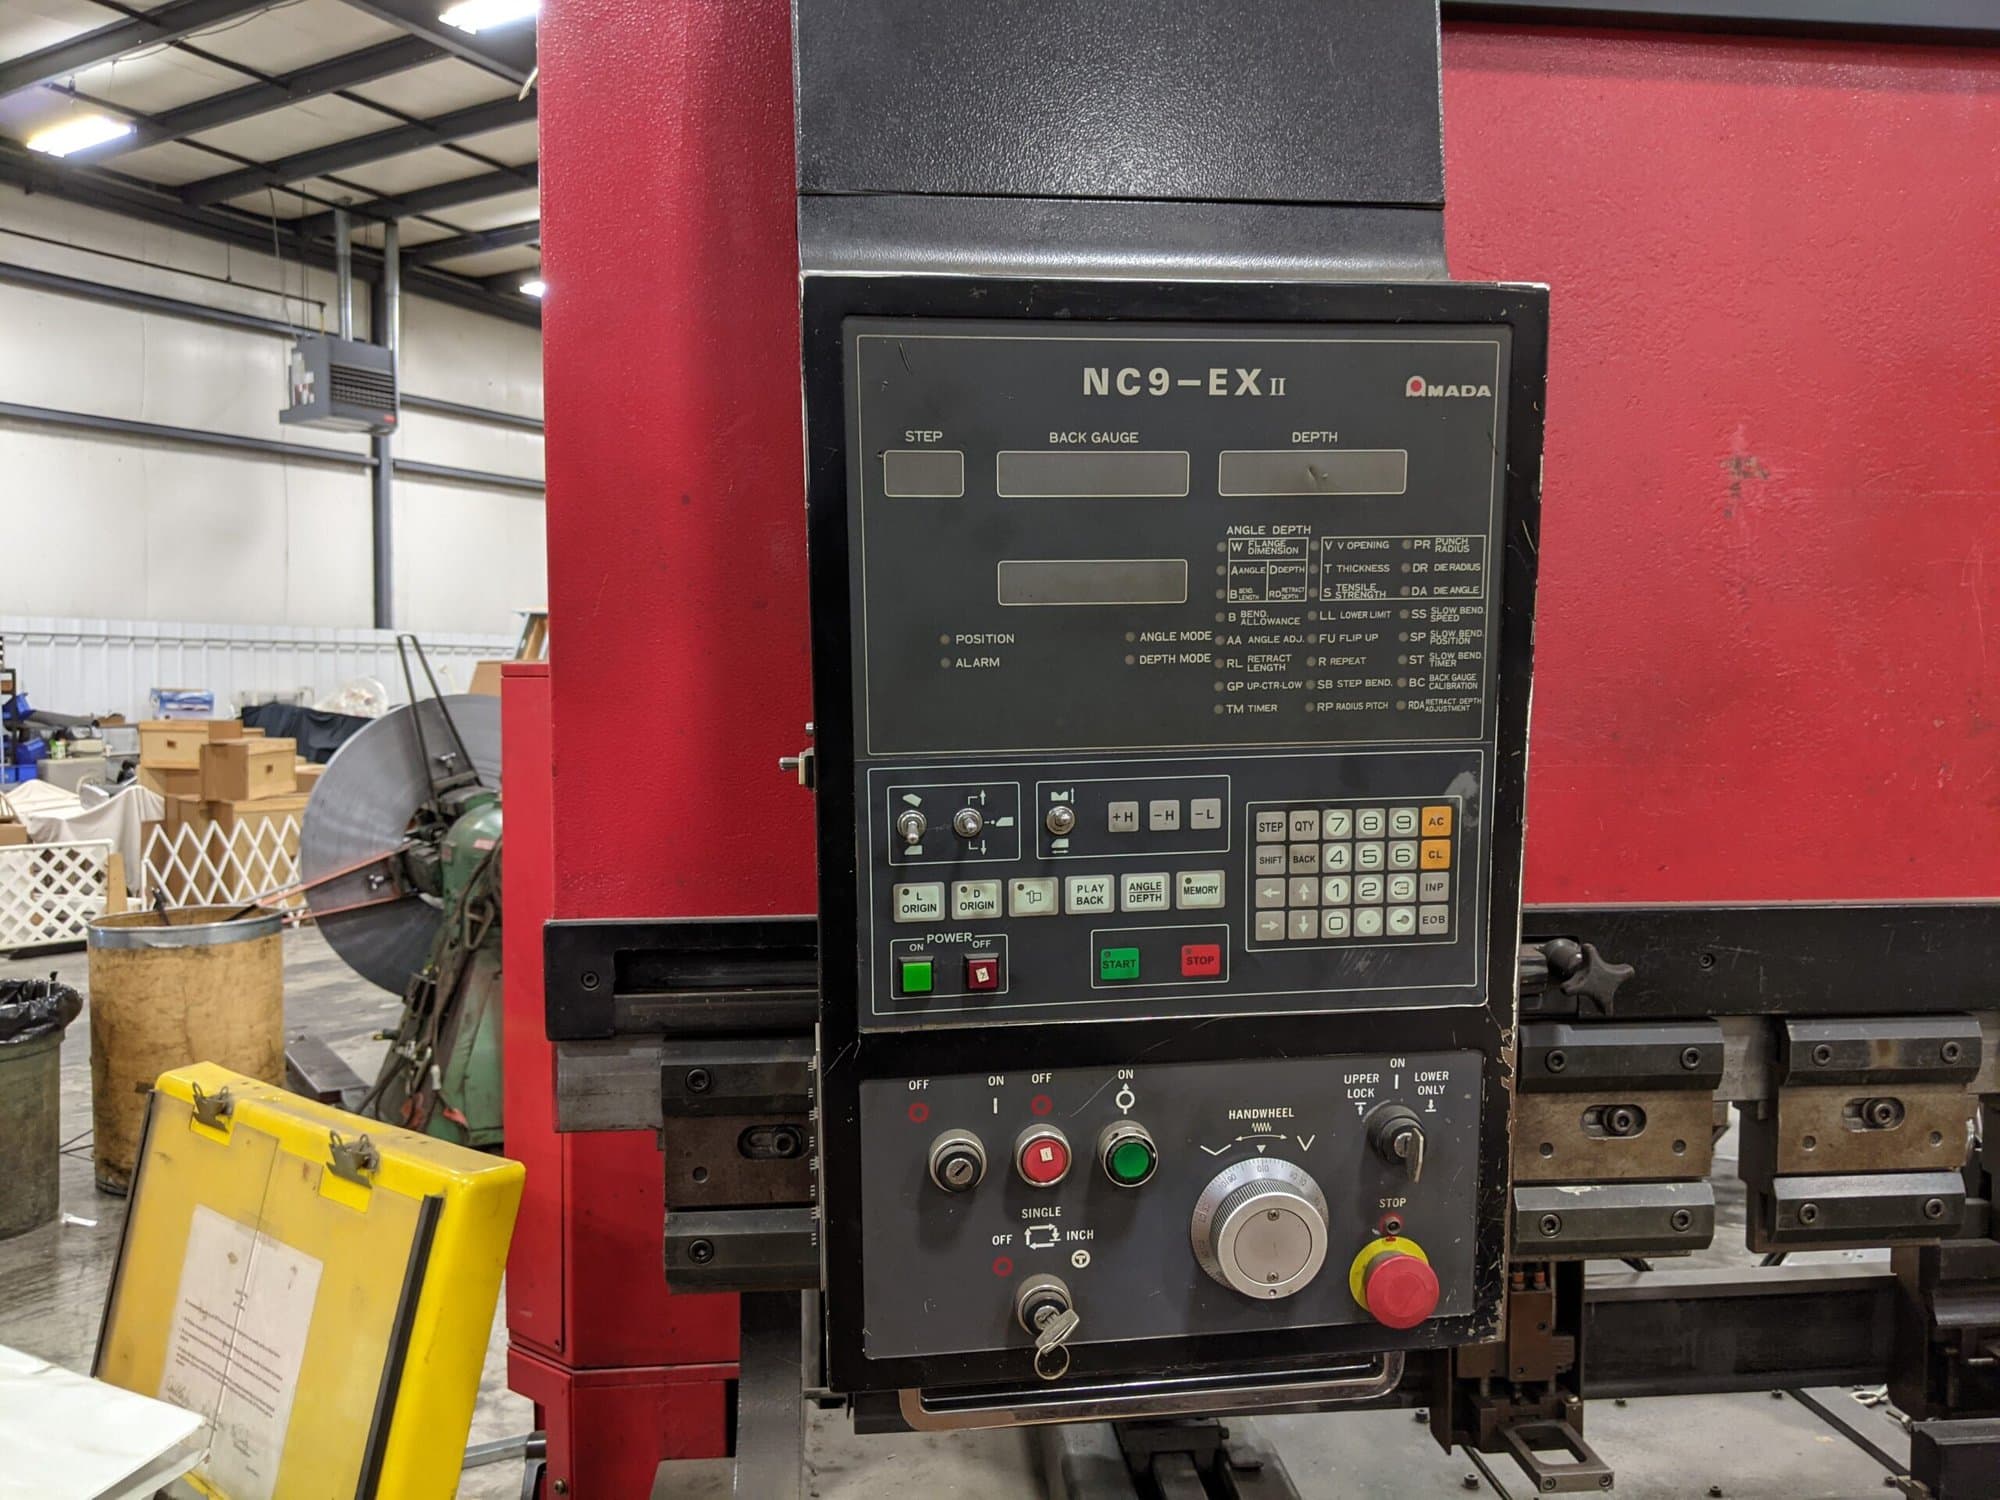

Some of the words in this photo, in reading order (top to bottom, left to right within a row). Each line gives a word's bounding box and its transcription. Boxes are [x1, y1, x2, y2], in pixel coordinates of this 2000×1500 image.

[1082, 366, 1262, 397] NC9-EX
[1405, 375, 1492, 398] AMADA
[904, 430, 944, 443] STEP
[1049, 431, 1087, 444] BACK
[1091, 431, 1139, 444] GAUGE
[1291, 431, 1338, 444] DEPTH
[1226, 525, 1267, 536] ANGLE
[1272, 525, 1312, 535] DEPTH
[1231, 541, 1243, 552] W
[1248, 539, 1287, 548] FLANGE
[1324, 540, 1334, 550] V
[1337, 542, 1345, 550] V
[1347, 540, 1390, 550] OPENING
[1413, 539, 1431, 550] PR
[1435, 537, 1469, 546] PUNCH
[1247, 546, 1299, 556] DIMENSION
[1434, 544, 1471, 553] RADIUS
[1230, 565, 1239, 576] A
[1239, 566, 1266, 575] ANGLE
[1269, 565, 1278, 575] D
[1278, 566, 1306, 574] DEPTH
[1324, 563, 1333, 574] T
[1336, 563, 1391, 574] THICKNESS
[1412, 562, 1429, 573] DR
[1433, 563, 1449, 572] DIE
[1449, 562, 1482, 572] RADIUS
[1323, 587, 1332, 598] S
[1336, 583, 1377, 592] TENSILE
[1411, 586, 1428, 596] DA
[1433, 586, 1448, 595] DIE
[1449, 585, 1480, 594] ANGLE
[1230, 589, 1238, 600] B
[1269, 589, 1281, 599] RD
[1335, 590, 1387, 600] STRENGTH
[1319, 610, 1337, 621] LL
[1340, 609, 1369, 619] LOWER
[1369, 609, 1392, 619] LIMIT
[1411, 608, 1428, 619] SS
[1430, 606, 1457, 615] SLOW
[1227, 612, 1237, 623] B
[1240, 616, 1301, 626] ALLOWANCE
[1430, 614, 1460, 623] SPEED
[955, 633, 1015, 645] POSITION
[1139, 631, 1177, 642] ANGLE
[1180, 630, 1212, 641] MODE
[1226, 635, 1242, 645] AA
[1247, 635, 1280, 644] ANGLE
[1283, 634, 1304, 643] ADJ.
[1319, 633, 1336, 643] FU
[1339, 634, 1362, 643] FLIP
[1365, 633, 1379, 642] UP
[1410, 632, 1427, 643] SP
[1430, 630, 1457, 639] SLOW
[1430, 637, 1471, 645] POSITION
[1139, 654, 1175, 665] DEPTH
[1179, 653, 1211, 664] MODE
[1247, 654, 1293, 663] RETRACT
[1318, 656, 1327, 667] R
[1330, 656, 1367, 665] REPEAT
[1409, 654, 1425, 665] ST
[1429, 652, 1456, 660] SLOW
[955, 657, 1000, 668] ALARM
[1226, 658, 1243, 669] RL
[1247, 663, 1286, 672] LENGTH
[1429, 659, 1457, 668] TIMER
[1408, 677, 1426, 688] BC
[1429, 674, 1449, 682] BACK
[1451, 673, 1477, 681] GAUGE
[1226, 681, 1244, 692] GP
[1247, 680, 1303, 690] UP-CTR-LOW
[1317, 679, 1334, 690] SB
[1336, 679, 1362, 689] STEP
[1365, 678, 1393, 688] BEND.
[1429, 681, 1478, 690] CALIBRATION
[1317, 702, 1334, 712] RP
[1336, 702, 1364, 711] RADIUS
[1366, 701, 1389, 711] PITCH
[1408, 700, 1425, 711] RDA
[1459, 697, 1482, 706] DEPTH
[1226, 704, 1244, 714] TM
[1248, 704, 1278, 713] TIMER
[1294, 820, 1315, 833] QTY
[1331, 817, 1345, 832] 7
[1363, 816, 1379, 831] 8
[1396, 815, 1412, 830] 9
[1428, 816, 1444, 827] AC
[1259, 822, 1284, 833] STEP
[1293, 855, 1316, 864] BACK
[1330, 850, 1344, 865] 4
[1362, 849, 1378, 864] 5
[1395, 848, 1411, 863] 6
[1428, 850, 1443, 860] CL
[1259, 856, 1283, 866] SHIFT
[1076, 884, 1104, 893] PLAY
[1129, 881, 1161, 891] ANGLE
[1183, 885, 1219, 896] MEMORY
[1332, 883, 1340, 897] 1
[1361, 882, 1377, 897] 2
[1394, 881, 1410, 896] 3
[1425, 882, 1444, 893] INP
[916, 892, 923, 901] L
[973, 889, 981, 898] D
[1129, 892, 1162, 903] DEPTH
[959, 900, 994, 911] ORIGIN
[1076, 895, 1104, 905] BACK
[902, 903, 937, 914] ORIGIN
[1422, 914, 1446, 926] EOB
[926, 931, 974, 944] POWER
[909, 942, 924, 952] ON
[972, 938, 991, 949] OFF
[1103, 958, 1136, 970] START
[1186, 955, 1215, 967] STOP
[1389, 1057, 1406, 1069] ON
[1031, 1072, 1052, 1084] OFF
[1117, 1068, 1134, 1080] ON
[1343, 1072, 1380, 1085] UPPER
[1414, 1070, 1450, 1083] LOWER
[908, 1079, 930, 1091] OFF
[988, 1075, 1004, 1086] ON
[1346, 1087, 1375, 1099] LOCK
[1417, 1084, 1446, 1096] ONLY
[1228, 1106, 1295, 1120] HANDWHEEL
[1378, 1197, 1407, 1209] STOP
[1021, 1206, 1062, 1219] SINGLE
[991, 1234, 1013, 1246] OFF
[1066, 1230, 1094, 1241] INCH
